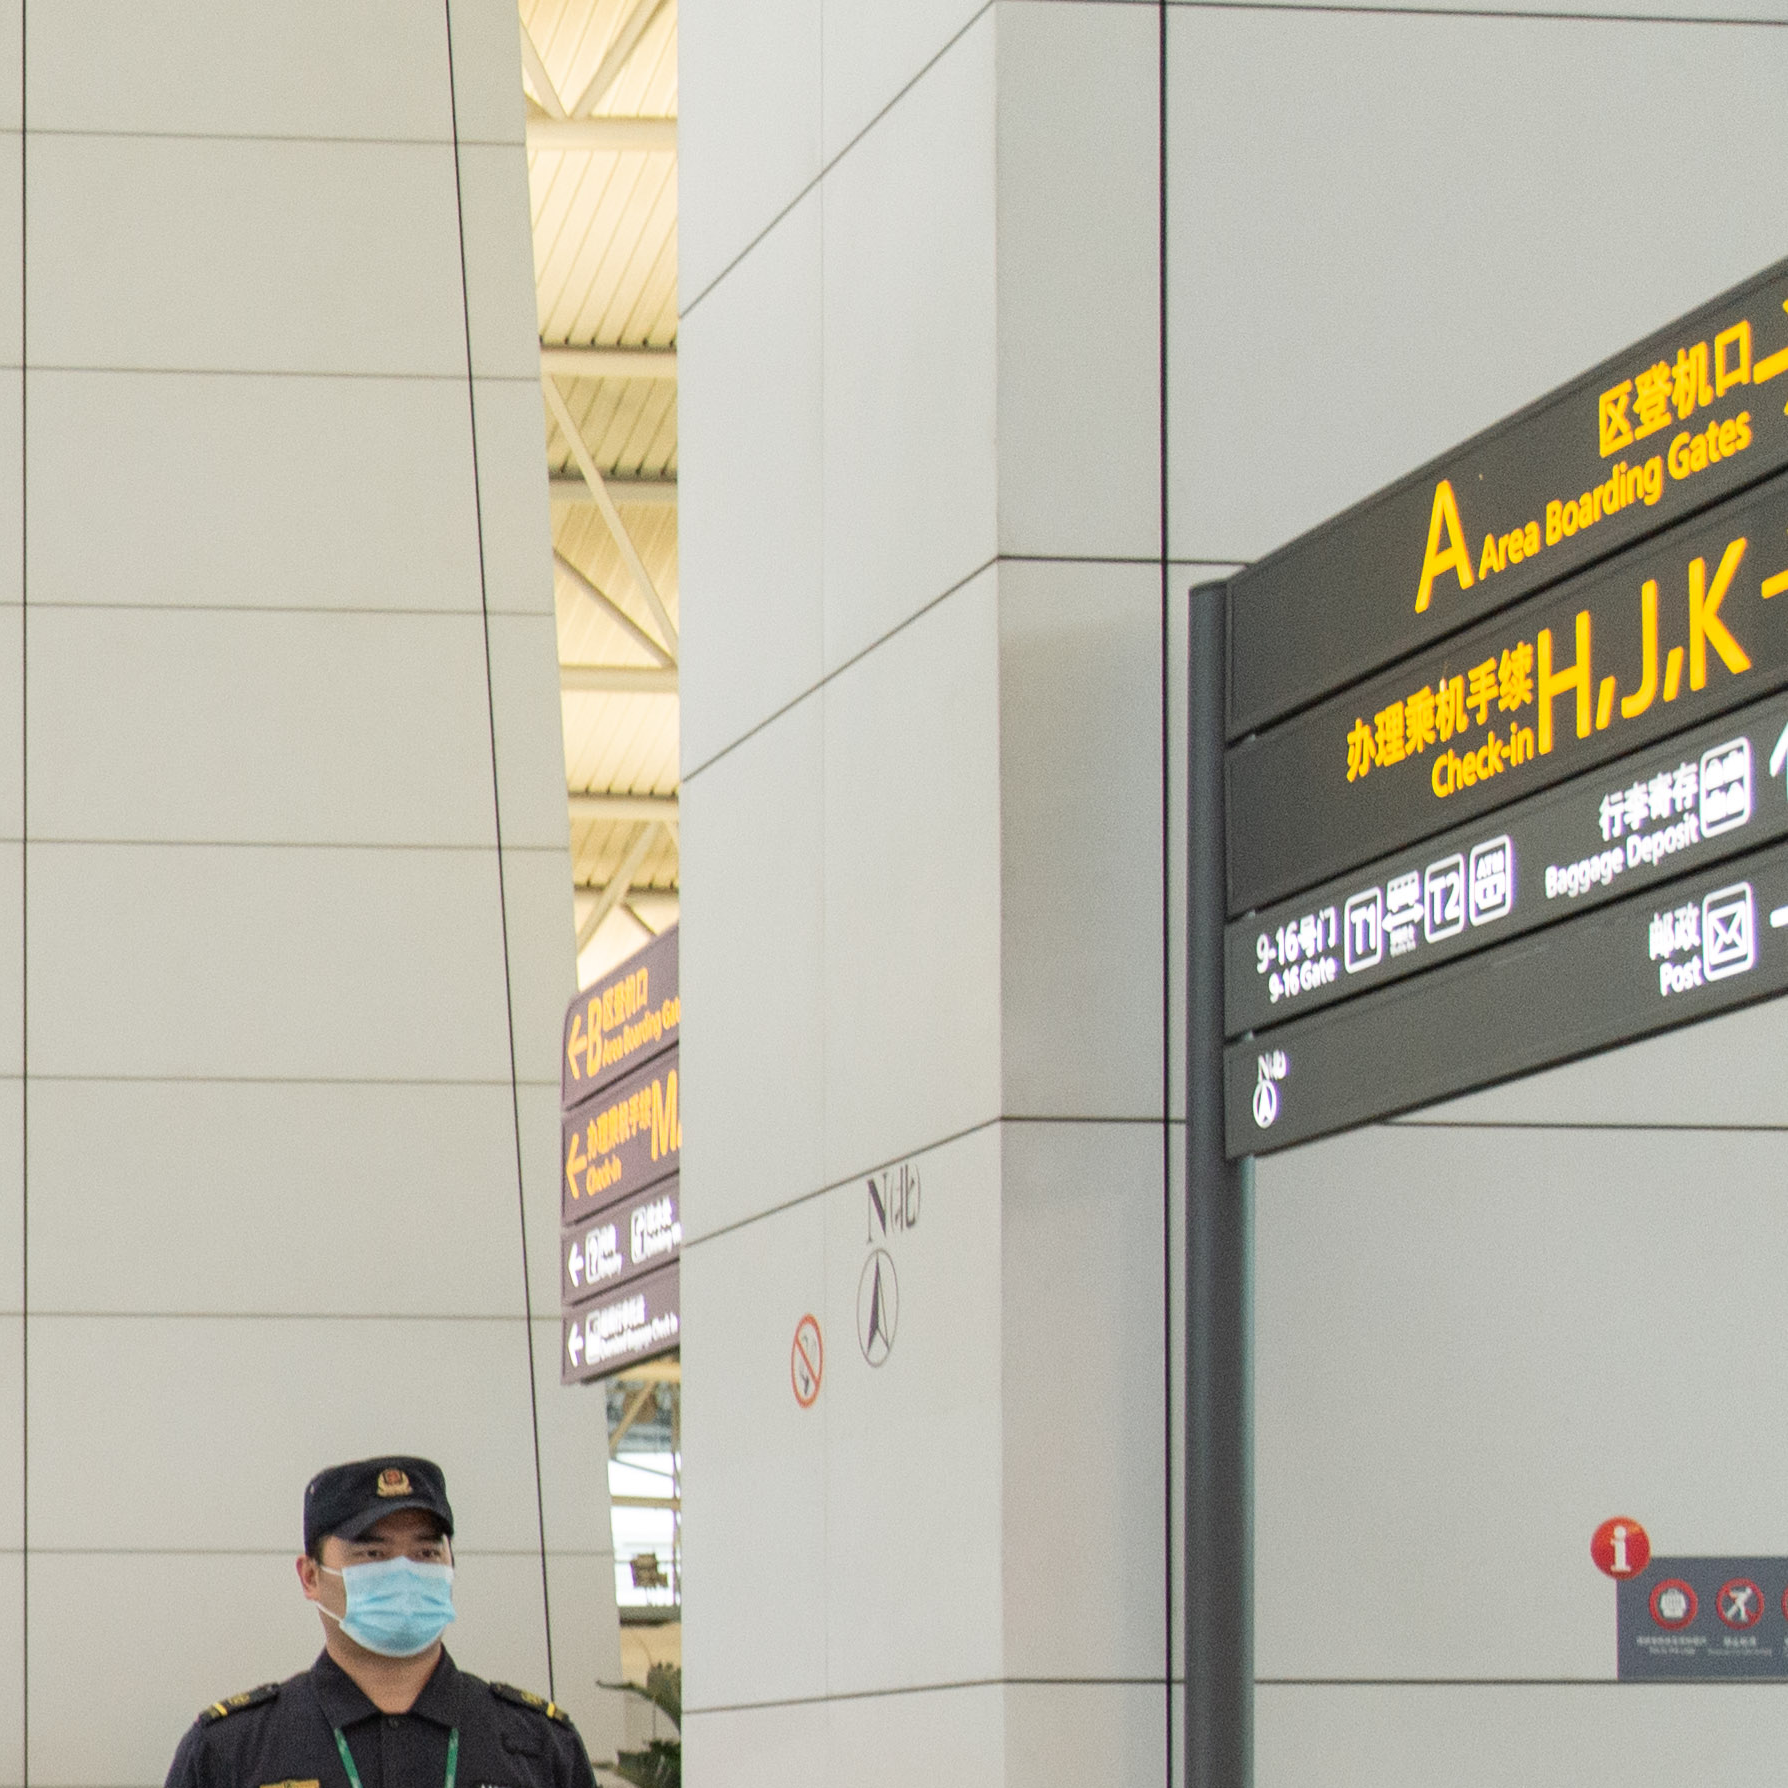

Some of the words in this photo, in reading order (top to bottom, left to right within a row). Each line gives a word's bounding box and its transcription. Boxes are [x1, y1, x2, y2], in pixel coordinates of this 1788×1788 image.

[1599, 320, 1751, 458] 区登机口
[1415, 480, 1475, 613] A
[1478, 521, 1540, 580] Area
[1545, 455, 1662, 547] Boarding
[1668, 411, 1751, 480] Gates
[1346, 641, 1534, 782] 办理乘机手续
[1432, 722, 1534, 798] Check-in
[1598, 762, 1699, 842] 行李寄存
[1545, 847, 1624, 898] Baggage
[1627, 813, 1699, 866] Deposit
[1350, 903, 1377, 955] T1
[1429, 872, 1461, 925] T2
[1299, 956, 1337, 990] Gate
[1660, 955, 1702, 996] Post
[587, 997, 602, 1078] B
